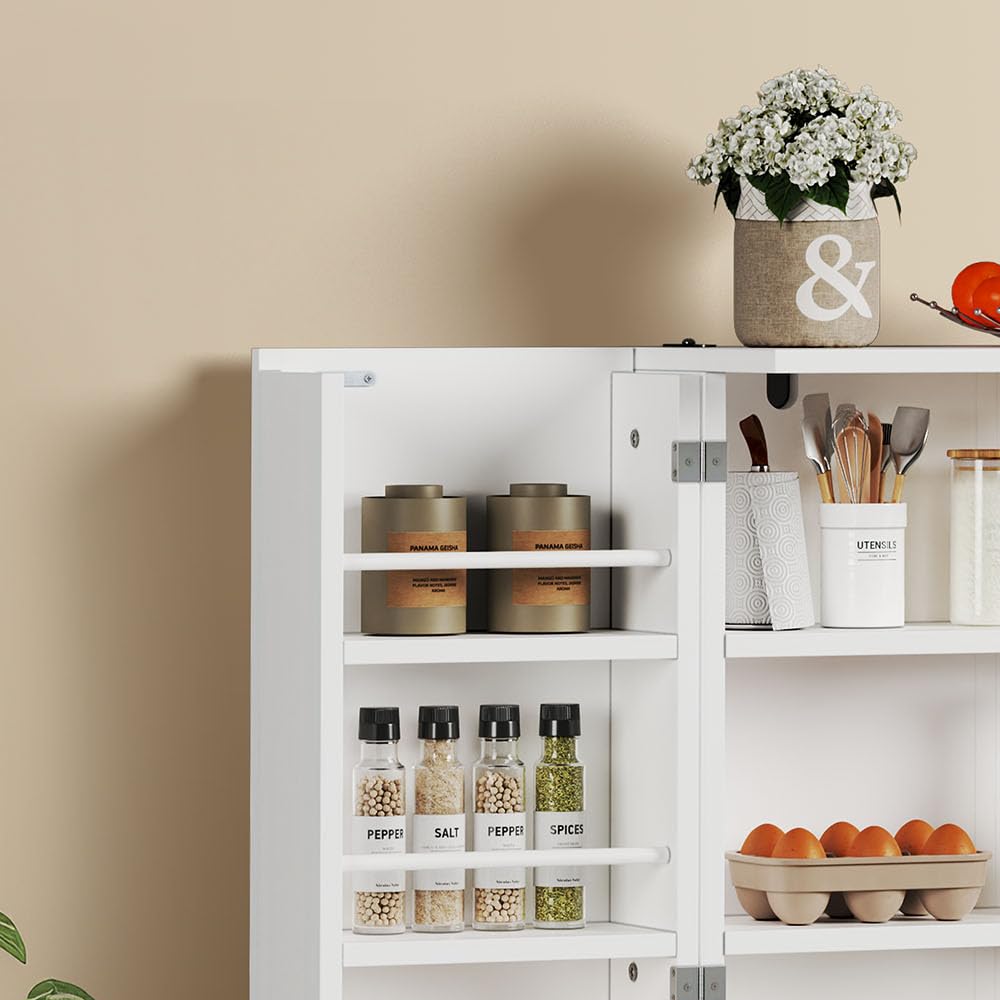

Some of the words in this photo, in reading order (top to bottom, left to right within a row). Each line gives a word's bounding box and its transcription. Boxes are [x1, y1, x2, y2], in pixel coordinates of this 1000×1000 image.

[857, 540, 897, 550] UTENSILS
[367, 829, 404, 840] PEPPER
[434, 827, 460, 838] SALT
[488, 825, 525, 837] PEPPER
[550, 824, 584, 835] SPICES
